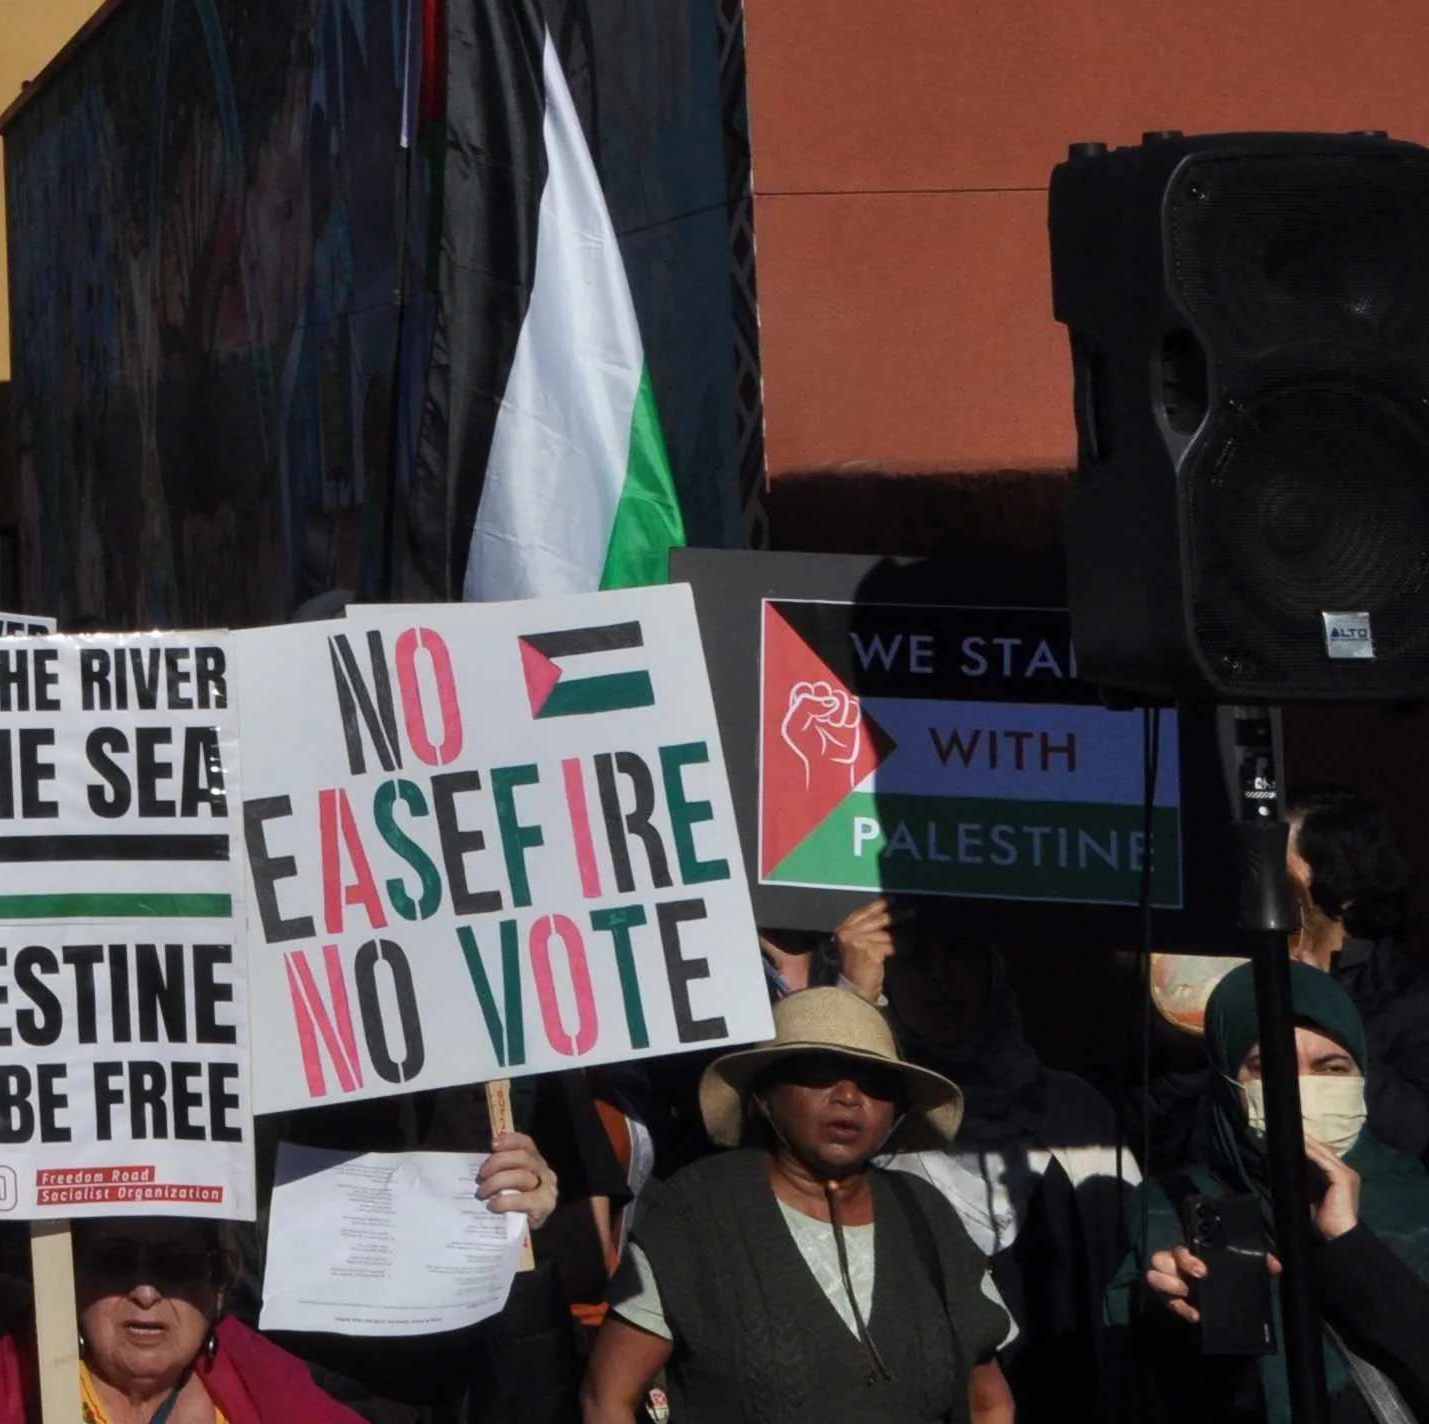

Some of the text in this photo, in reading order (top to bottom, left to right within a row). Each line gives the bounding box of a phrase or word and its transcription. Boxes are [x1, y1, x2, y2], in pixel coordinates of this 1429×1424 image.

[80, 647, 228, 711] RIVER
[850, 632, 1077, 678] WE STA
[328, 626, 464, 776] NO
[85, 727, 228, 818] SEA
[929, 727, 1077, 773] WITH
[242, 740, 732, 944] EASEFIRE
[853, 816, 1156, 873] PALESTINE
[284, 898, 730, 1098] NO VOTE
[93, 1061, 243, 1143] FREE
[42, 1168, 149, 1185] Freedom Road
[42, 1184, 219, 1202] Socialist Organization
